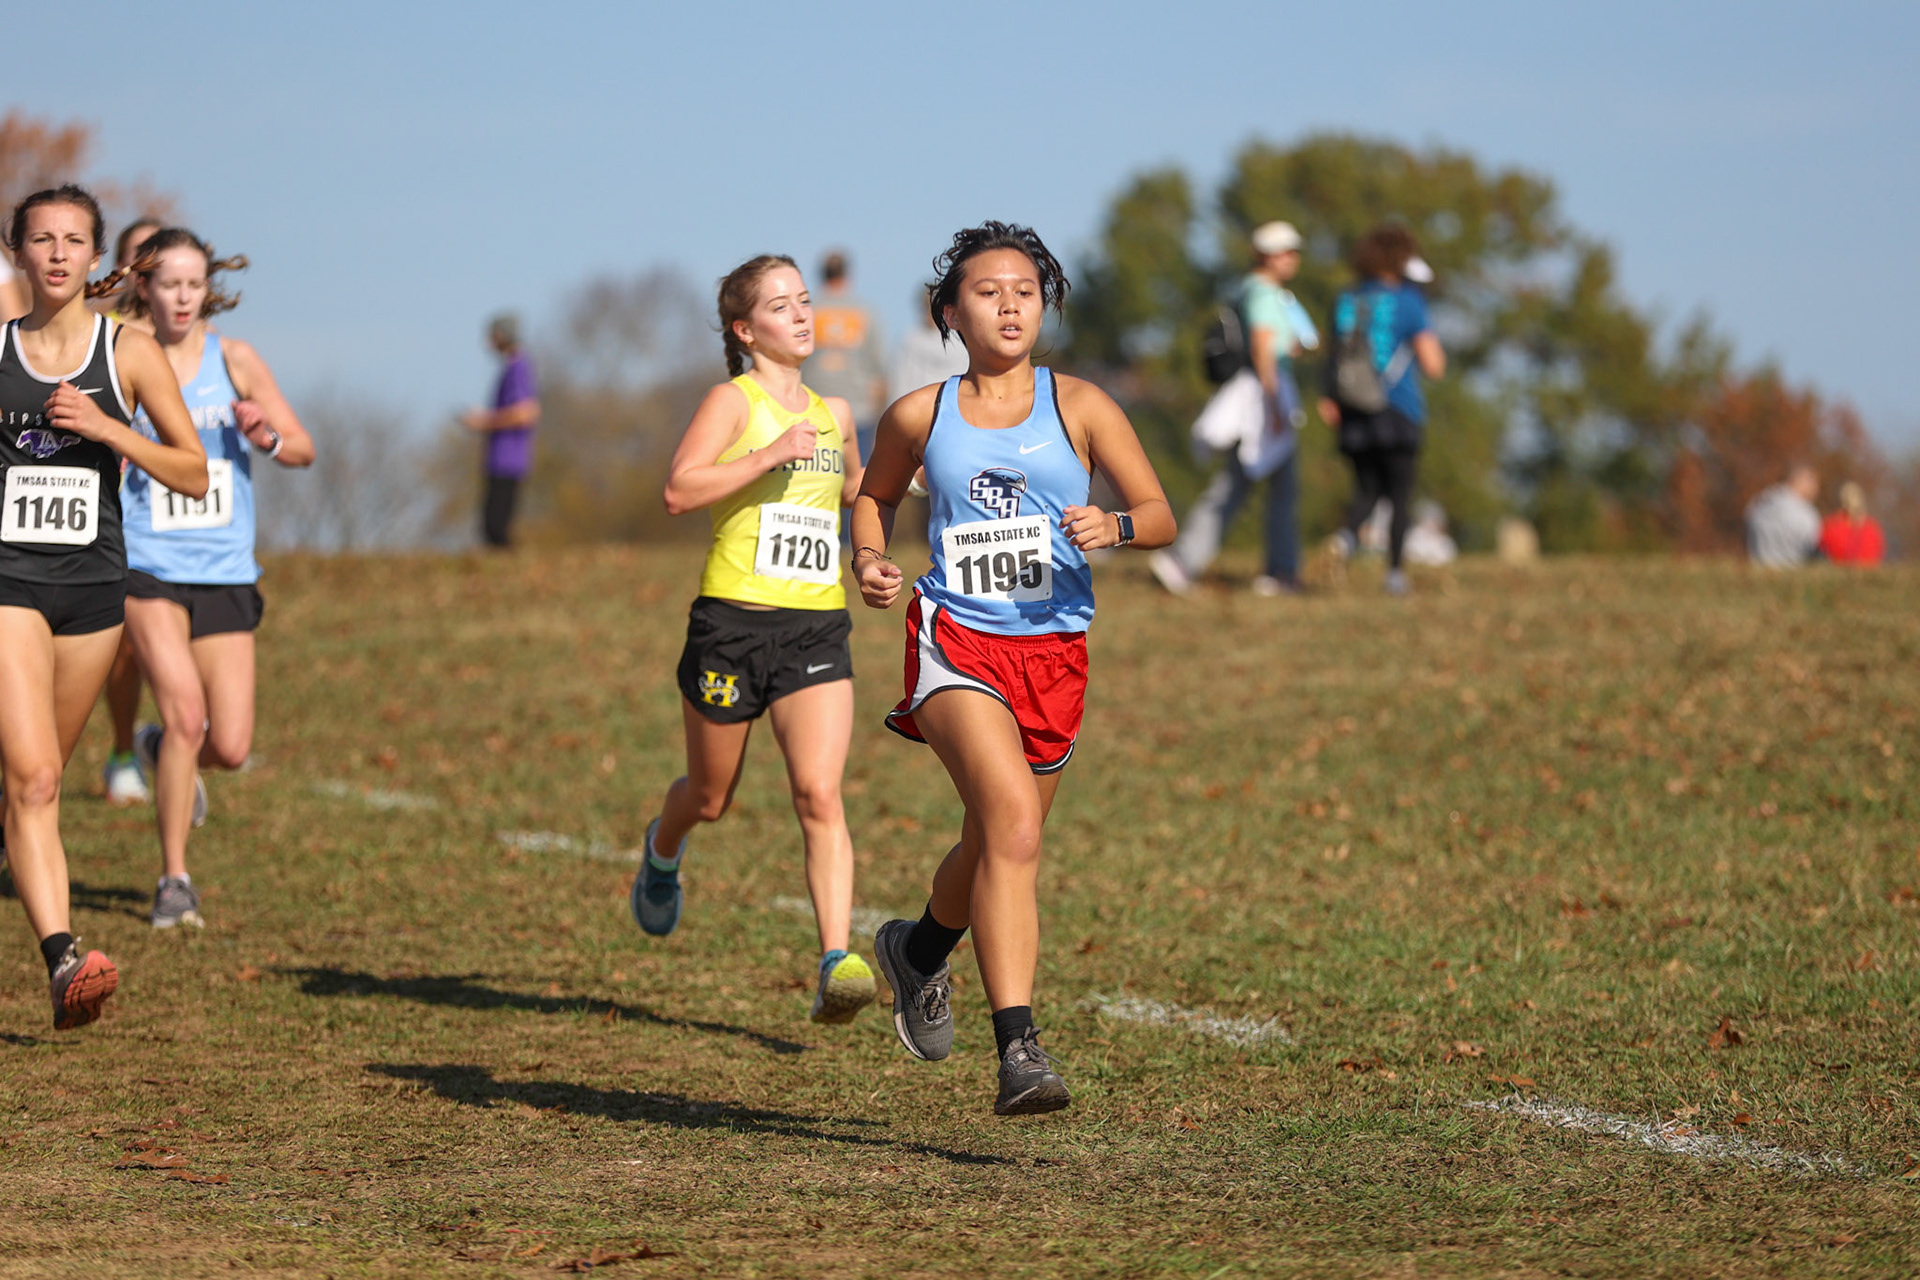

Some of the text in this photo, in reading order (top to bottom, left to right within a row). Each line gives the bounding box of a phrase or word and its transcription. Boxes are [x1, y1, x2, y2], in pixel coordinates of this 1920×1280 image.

[16, 476, 48, 487] TMSAA
[50, 477, 77, 488] STATE
[971, 478, 1019, 519] SBA
[13, 496, 87, 531] 1146
[769, 533, 830, 571] 1120
[954, 526, 1040, 546] TMSAA STATE XC
[955, 548, 1043, 595] 1195
